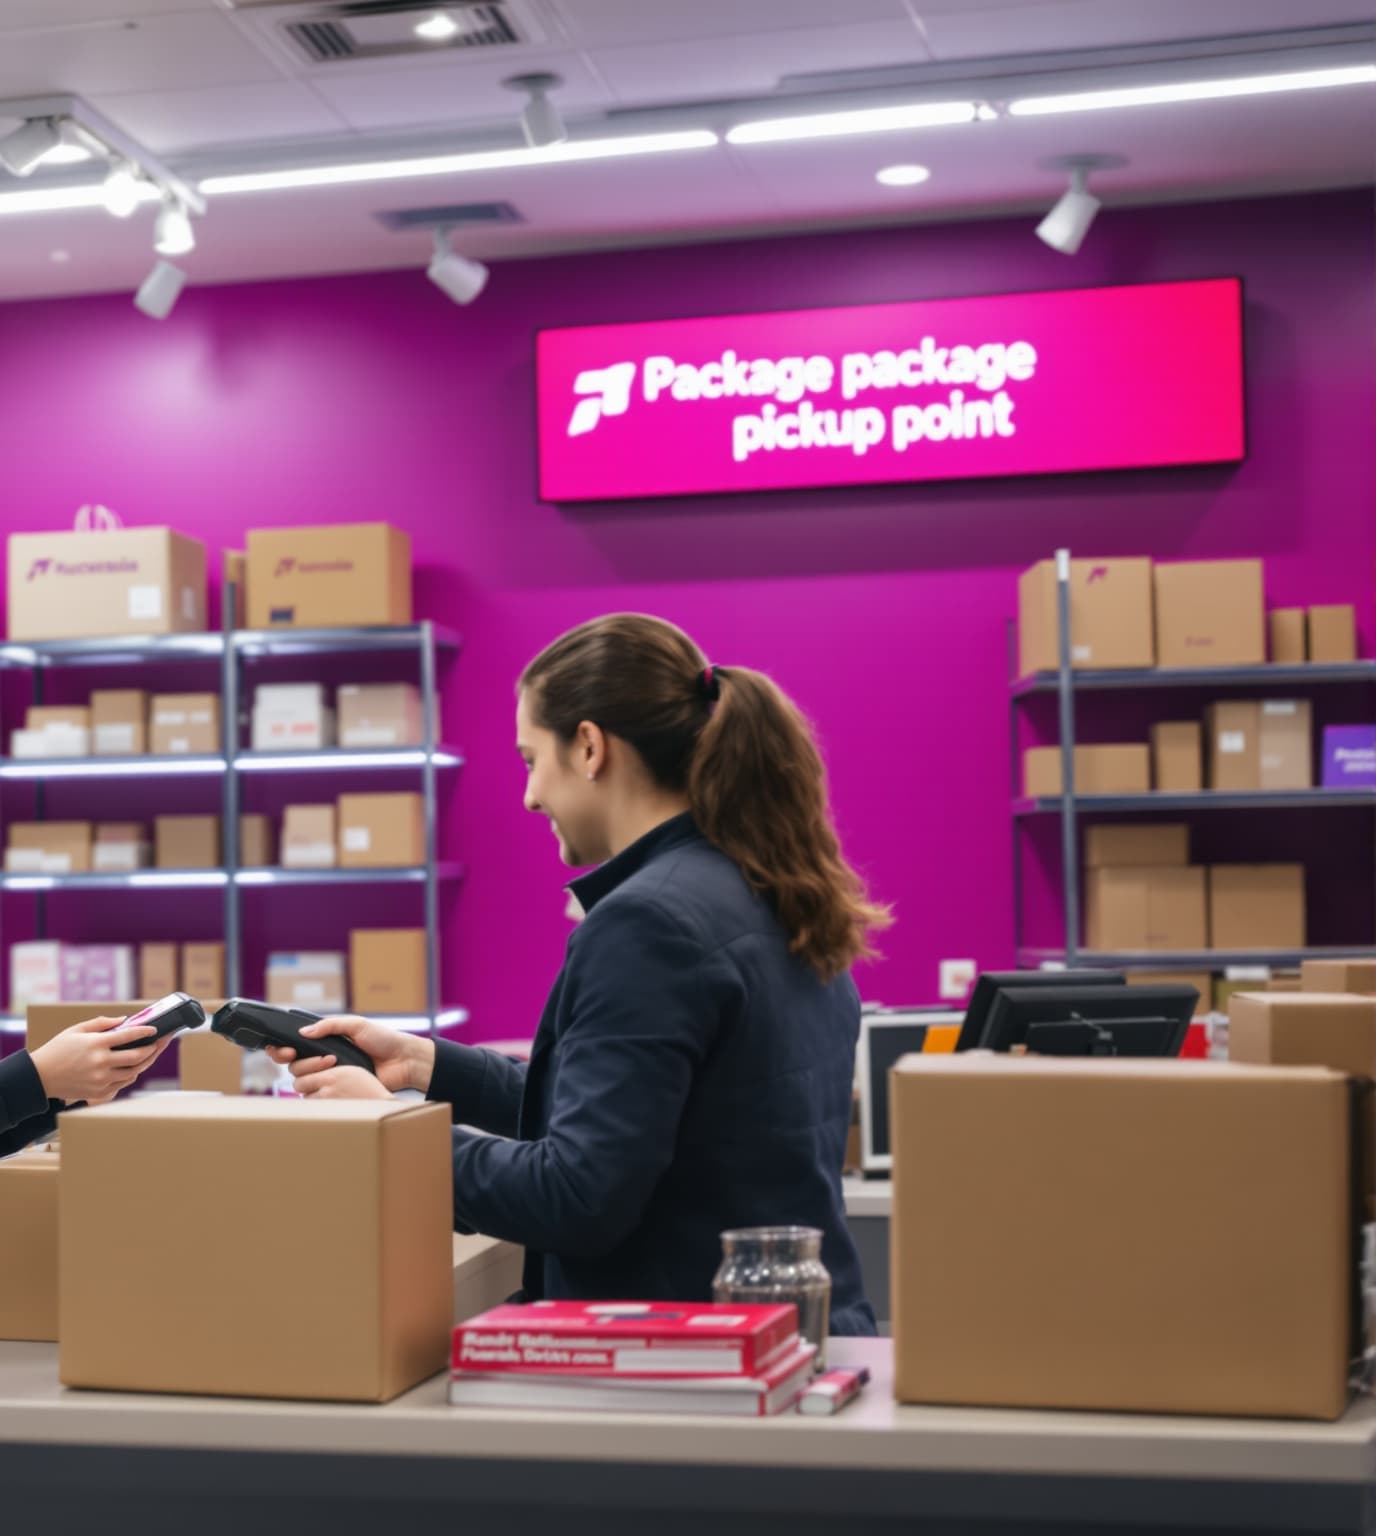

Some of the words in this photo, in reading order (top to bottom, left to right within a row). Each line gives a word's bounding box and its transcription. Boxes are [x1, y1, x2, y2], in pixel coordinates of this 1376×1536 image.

[643, 350, 834, 403] Package
[841, 336, 1038, 400] package
[732, 400, 885, 462] pickup
[891, 389, 1015, 452] point
